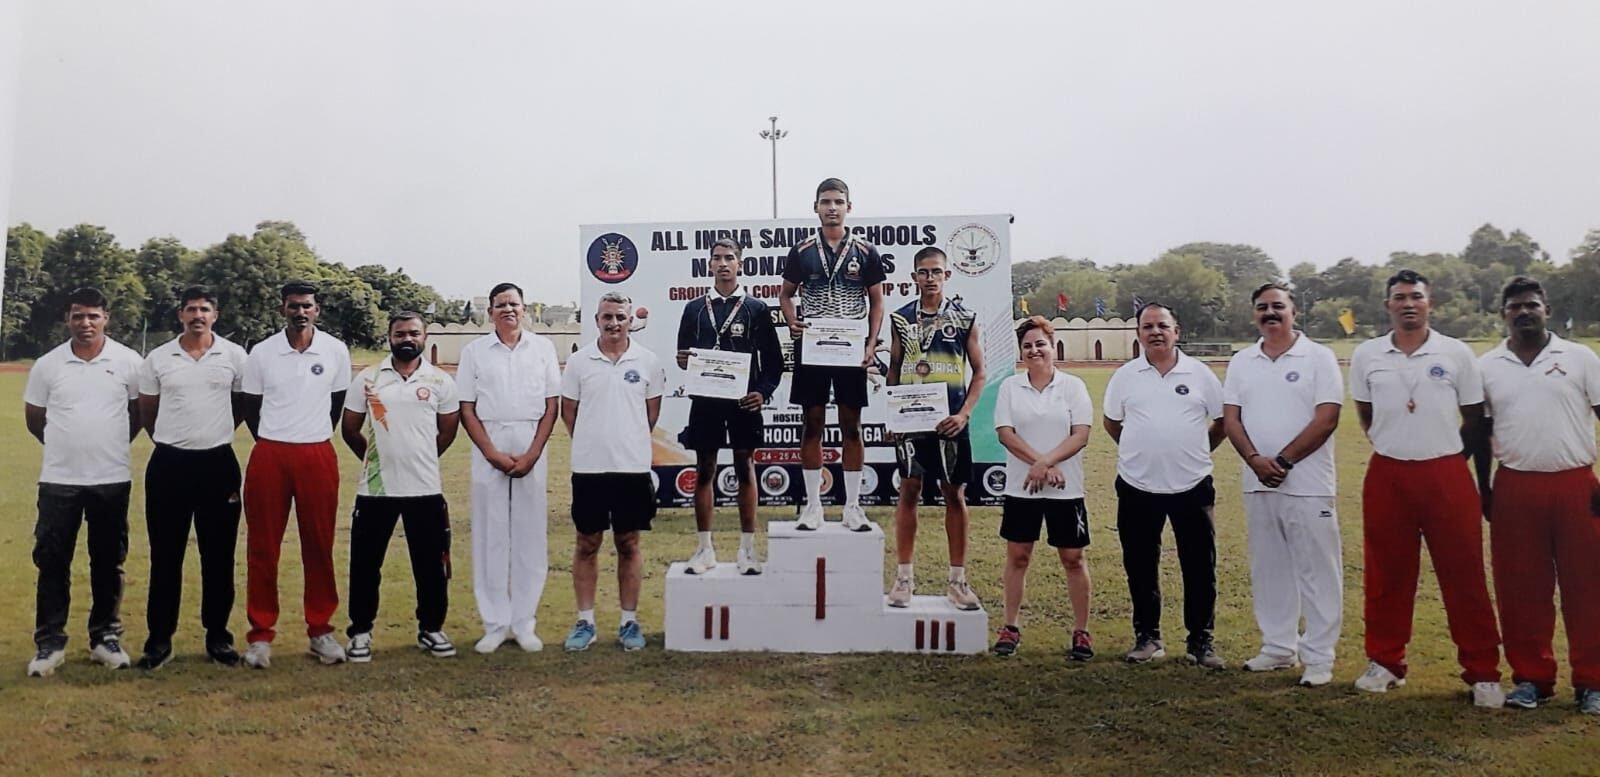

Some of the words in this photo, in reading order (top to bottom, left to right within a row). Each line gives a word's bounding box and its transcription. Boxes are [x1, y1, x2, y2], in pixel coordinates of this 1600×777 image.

[651, 231, 688, 251] ALL
[845, 225, 937, 246] CHOOLS
[763, 427, 800, 443] HOOL
